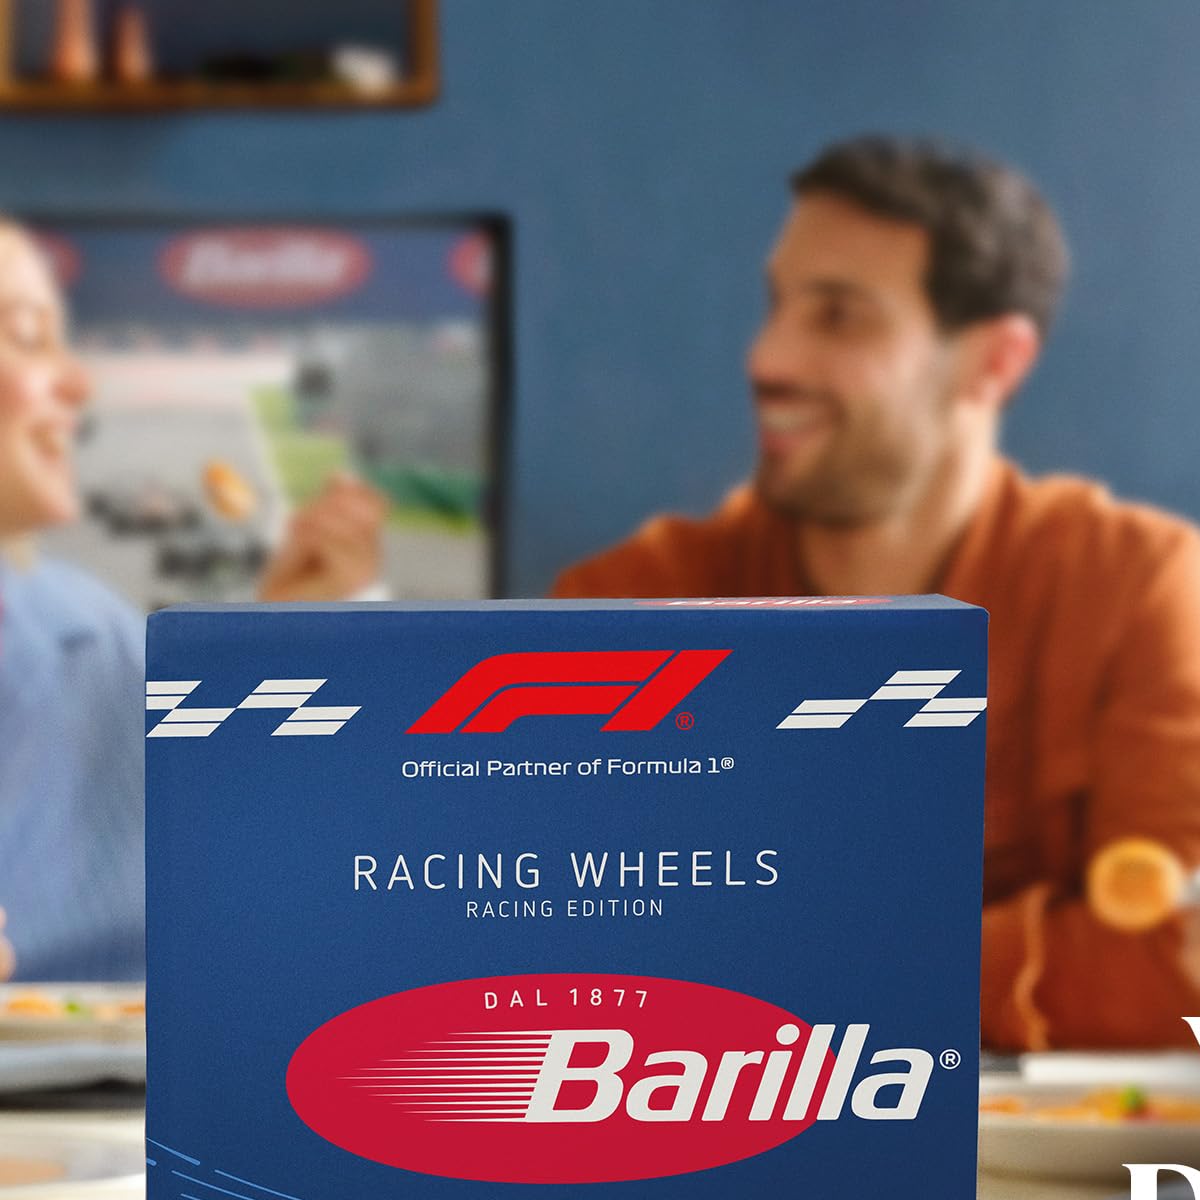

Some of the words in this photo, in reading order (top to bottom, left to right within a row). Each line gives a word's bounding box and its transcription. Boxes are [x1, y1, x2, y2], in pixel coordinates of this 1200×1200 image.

[401, 760, 479, 778] Official
[486, 758, 573, 777] Partner
[576, 757, 602, 776] of
[606, 757, 702, 776] Formula
[354, 852, 541, 891] RACING
[570, 849, 779, 888] WHEELS
[466, 900, 554, 918] RACING
[566, 898, 664, 917] EDITION
[484, 989, 549, 1010] DAL
[567, 987, 649, 1008] 1877
